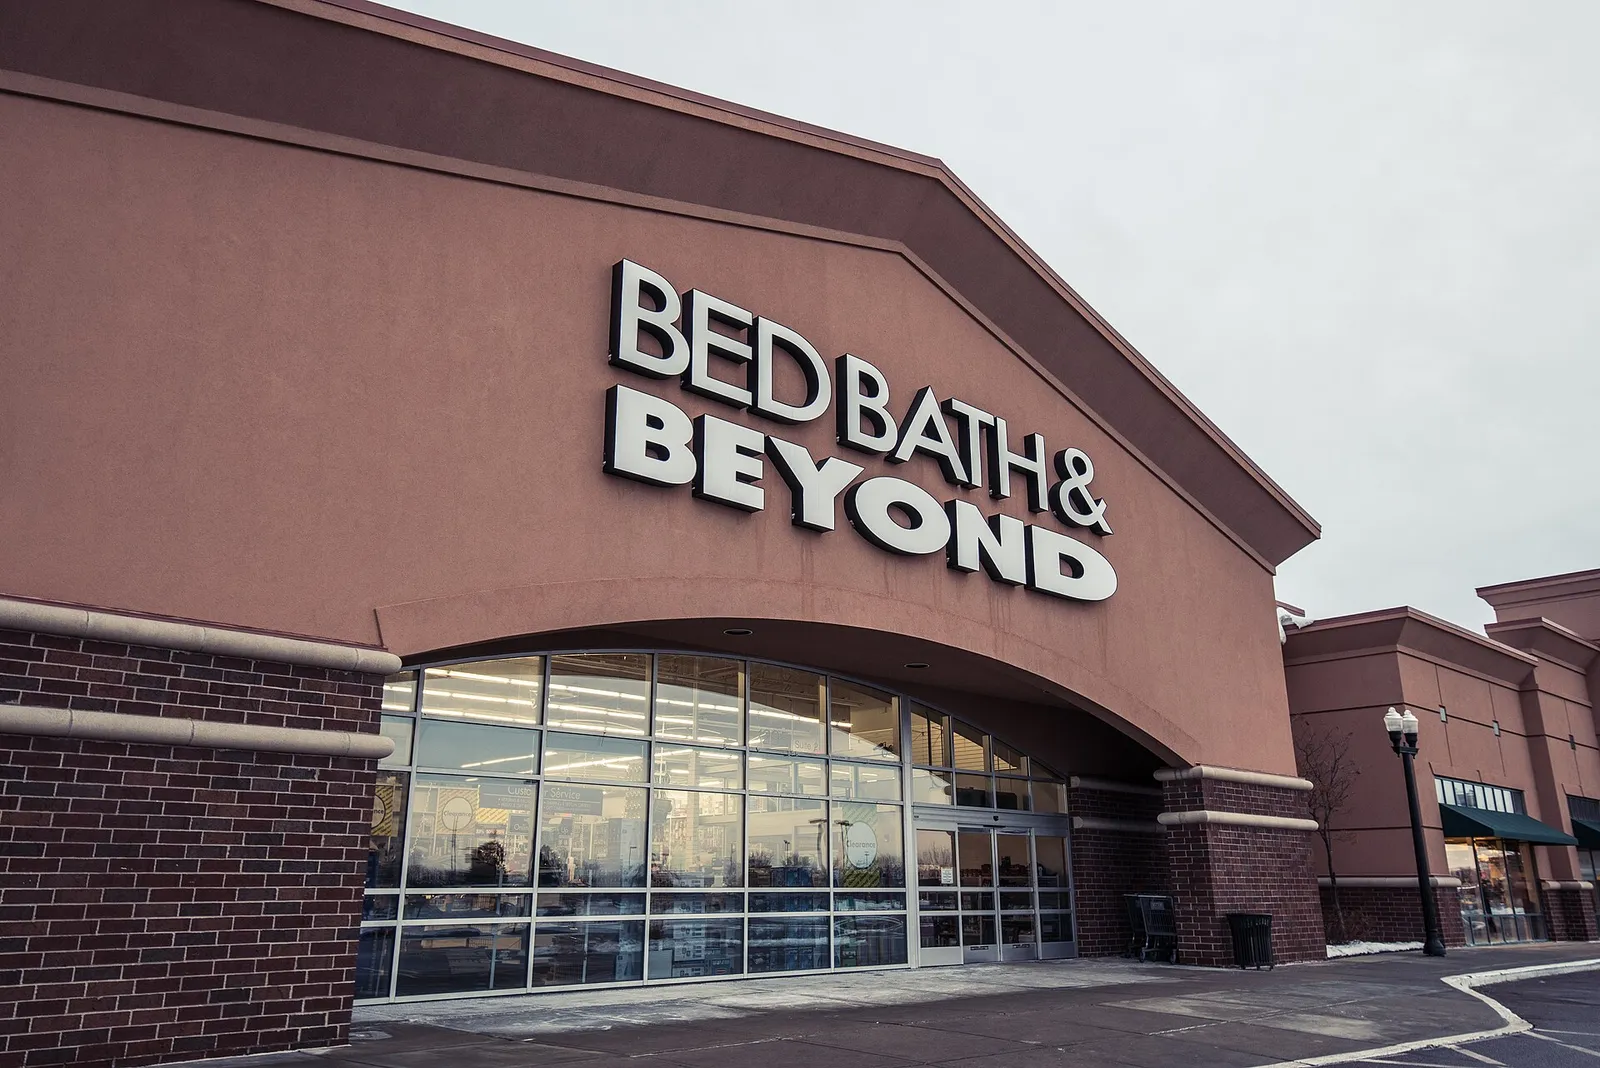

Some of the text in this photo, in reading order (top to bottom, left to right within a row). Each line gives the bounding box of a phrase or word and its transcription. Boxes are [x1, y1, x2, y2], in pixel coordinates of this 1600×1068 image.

[609, 258, 1113, 536] BED BATH &
[603, 384, 1118, 601] BEYOND
[507, 786, 580, 800] Custor Service
[443, 809, 472, 817] Clearance
[847, 840, 876, 848] Clearance
